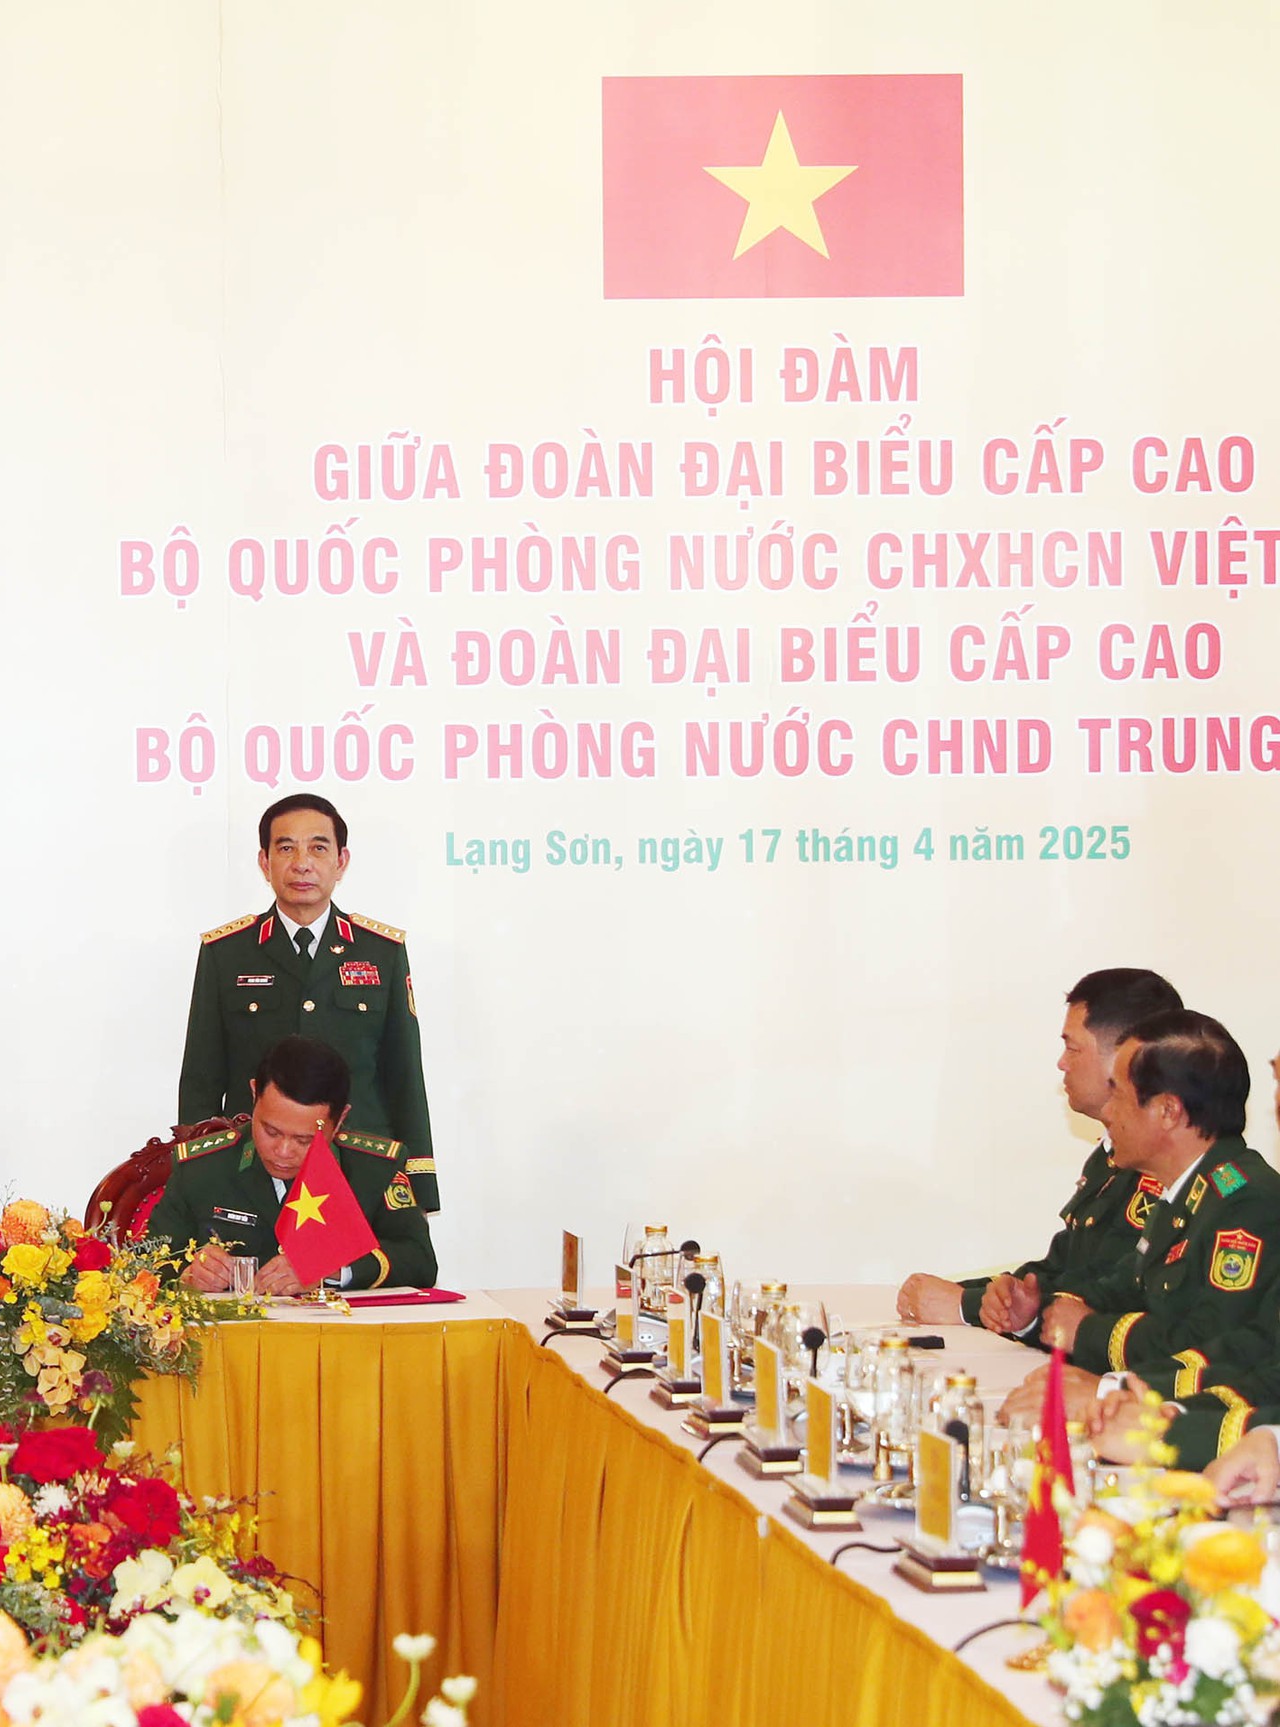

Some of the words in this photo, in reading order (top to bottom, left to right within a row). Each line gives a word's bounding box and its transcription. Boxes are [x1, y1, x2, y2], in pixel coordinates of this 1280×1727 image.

[651, 334, 752, 416] HỘI
[780, 333, 917, 402] ĐÀM
[315, 432, 459, 500] GIỮA
[485, 429, 652, 498] ĐOÀN
[681, 442, 782, 509] ĐẠI
[814, 414, 952, 495] BIỂU
[984, 418, 1104, 494] CẤP
[1133, 436, 1254, 494] CAO
[122, 527, 198, 608] BỘ
[230, 518, 398, 600] QUỐC
[430, 522, 639, 592] PHÒNG
[671, 521, 837, 590] NƯỚC
[868, 532, 1122, 589] CHXHCN
[1150, 516, 1280, 599] VIỆT
[350, 618, 426, 686] VÀ
[453, 616, 620, 685] ĐOÀN
[648, 629, 749, 696] ĐẠI
[782, 601, 919, 682] BIỂU
[950, 605, 1070, 681] CẤP
[1100, 622, 1221, 680] CAO
[138, 714, 214, 794] BỘ
[246, 704, 413, 786] QUỐC
[446, 710, 654, 778] PHÒNG
[687, 707, 853, 777] NƯỚC
[883, 719, 1051, 776] CHND
[1078, 715, 1280, 773] TRUNG
[447, 832, 531, 874] Lạng
[546, 830, 623, 869] Sơn,
[639, 836, 724, 874] ngày
[739, 828, 782, 863] 17
[797, 828, 899, 870] tháng
[913, 826, 935, 861] 4
[950, 828, 1024, 861] năm
[1040, 825, 1131, 860] 2025
